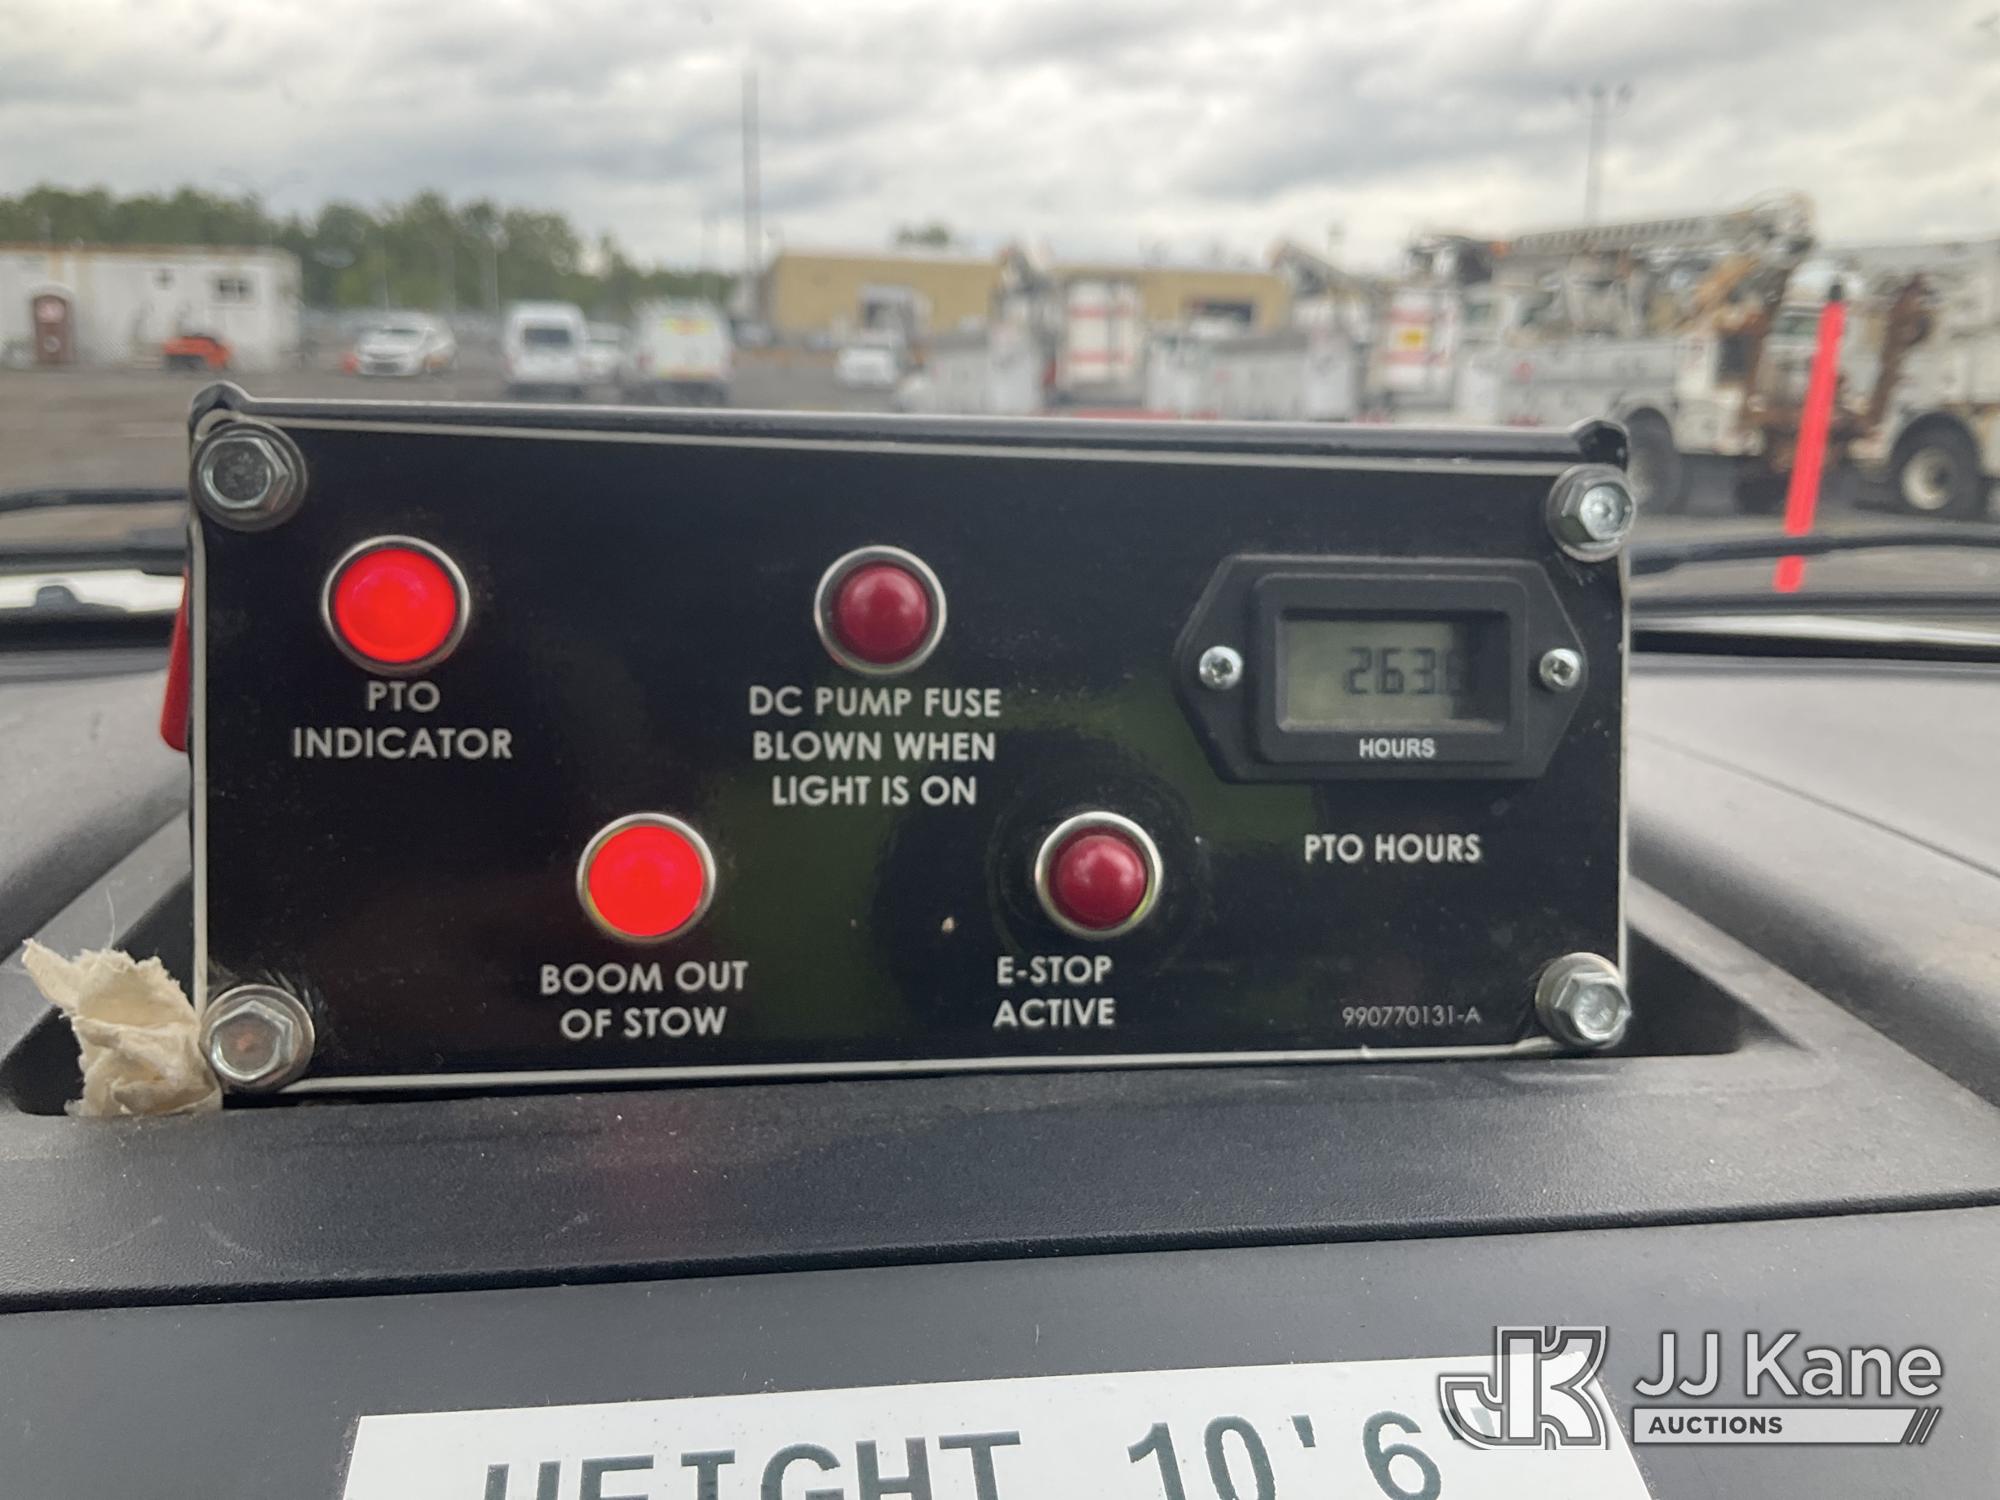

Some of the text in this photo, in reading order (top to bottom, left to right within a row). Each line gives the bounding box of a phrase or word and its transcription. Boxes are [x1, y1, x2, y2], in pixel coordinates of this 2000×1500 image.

[368, 680, 441, 712] PTO
[749, 685, 1001, 718] DC PUMP FUSE
[293, 726, 513, 759] INDICATOR
[752, 730, 996, 761] BLOWN WHEN
[1358, 737, 1437, 759] HOURS
[771, 775, 977, 806] LIGHT IS ON
[1304, 833, 1482, 863] PTO HOURS
[540, 960, 749, 995] BOOM OUT
[996, 954, 1112, 986] E-STOP
[560, 1005, 728, 1040] OF STOW
[993, 997, 1116, 1028] ACTIVE
[1341, 1004, 1483, 1029] 990770131-A
